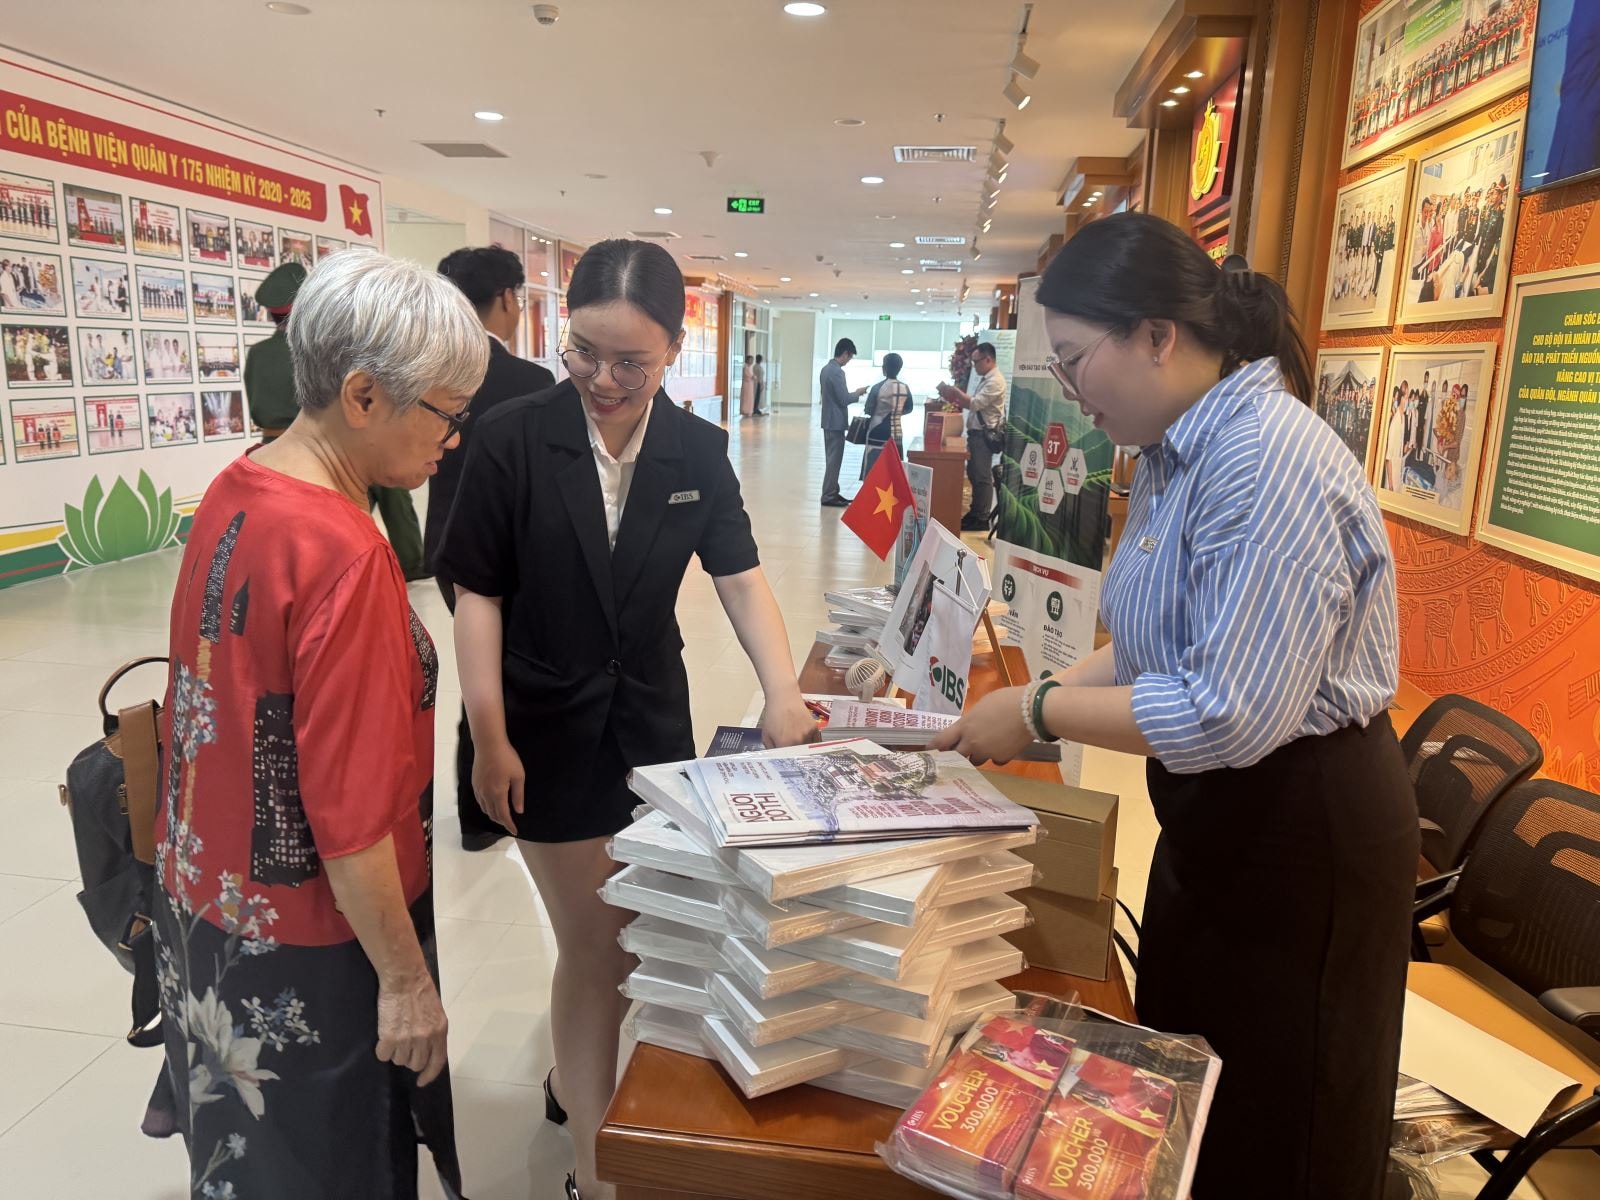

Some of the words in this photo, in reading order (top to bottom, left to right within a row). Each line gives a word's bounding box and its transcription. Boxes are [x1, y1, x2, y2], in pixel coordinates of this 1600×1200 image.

[6, 104, 43, 144] CỦA
[46, 118, 91, 156] BỆNH
[93, 132, 128, 168] VIỆN
[131, 143, 168, 175] QUÂN
[169, 152, 178, 177] Y
[181, 157, 203, 183] 175
[205, 164, 242, 195] NHIỆM
[243, 171, 256, 197] KỲ
[258, 178, 282, 203] 2020
[290, 186, 312, 211] 2025
[1583, 311, 1597, 325] SÓC
[1533, 335, 1544, 346] CHO
[1574, 371, 1587, 383] CAO
[1047, 440, 1060, 455] 3T
[1043, 624, 1054, 634] ĐÀO
[941, 664, 965, 711] IBS
[932, 1069, 989, 1130] VOUCHER
[1048, 1116, 1094, 1188] VOUCHER
